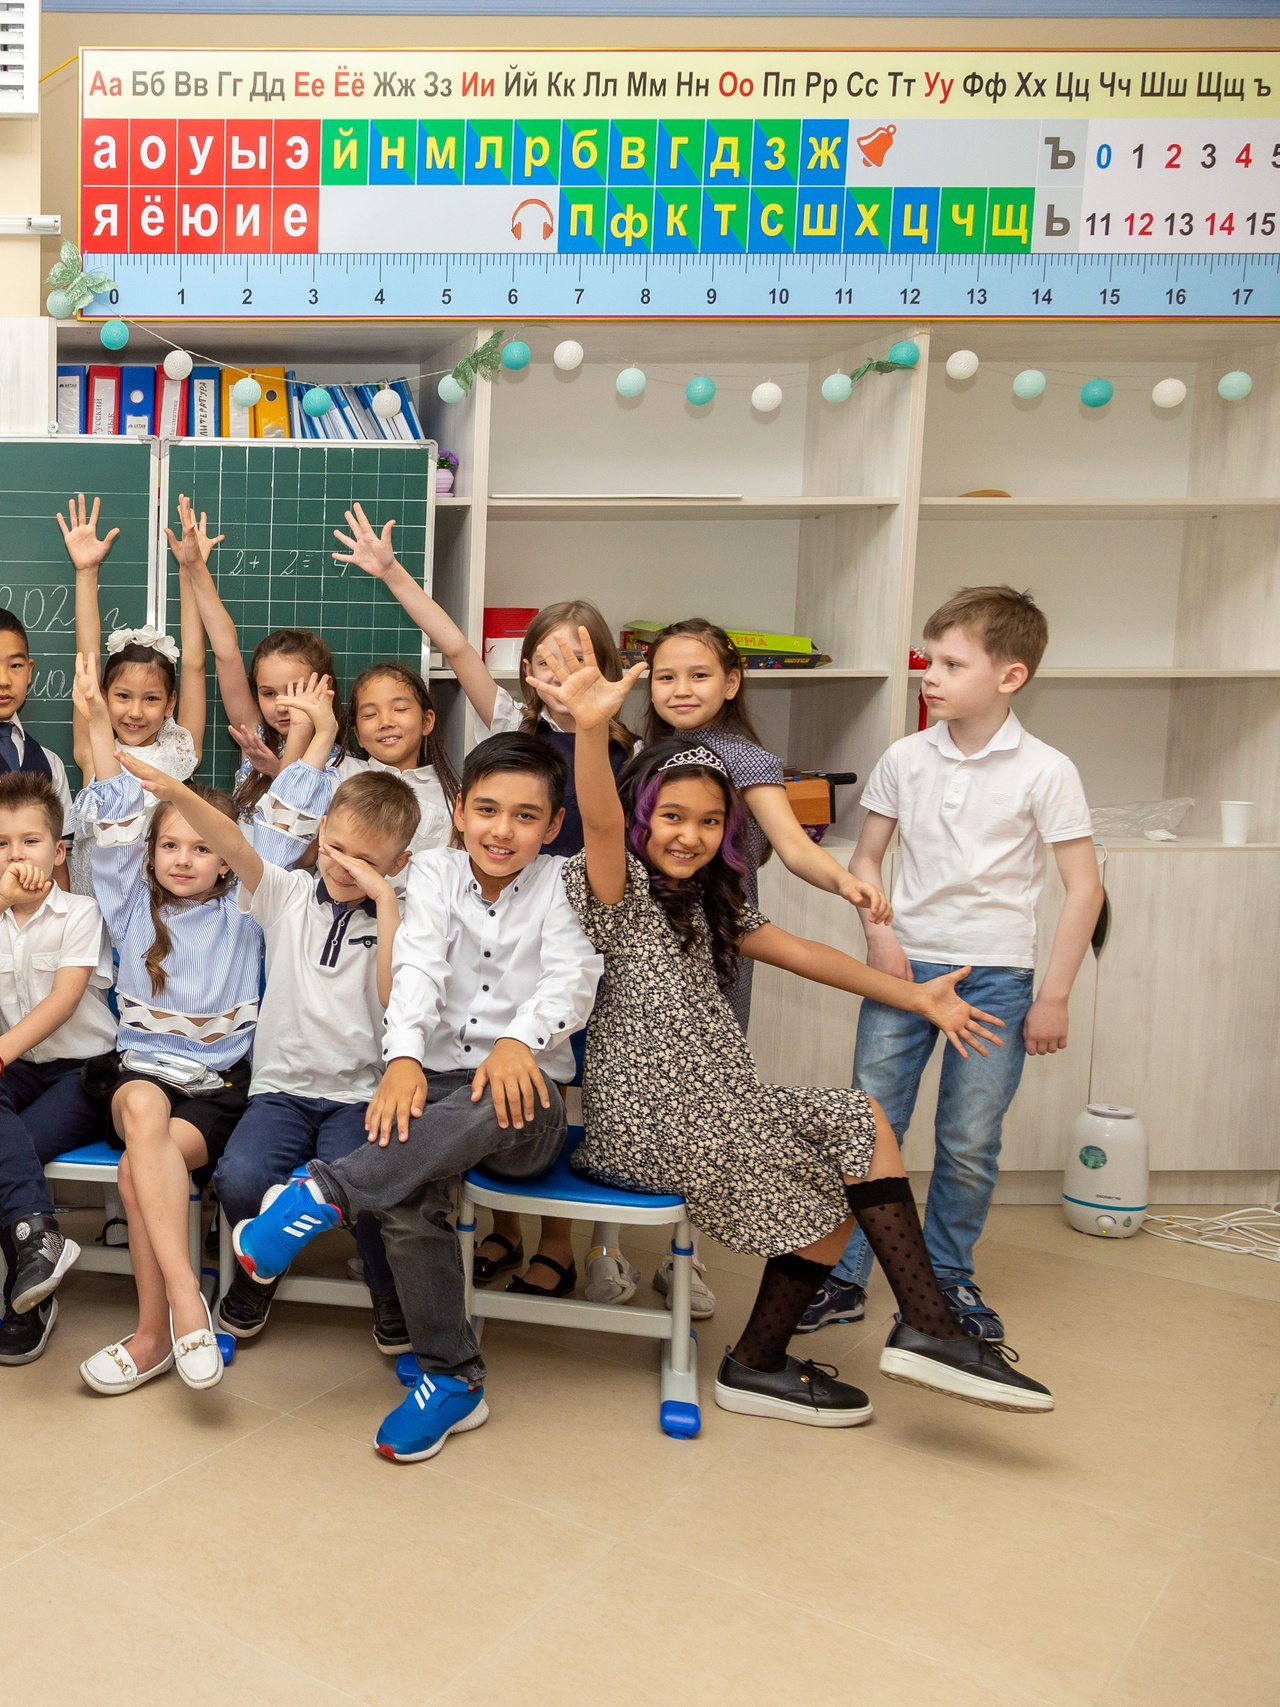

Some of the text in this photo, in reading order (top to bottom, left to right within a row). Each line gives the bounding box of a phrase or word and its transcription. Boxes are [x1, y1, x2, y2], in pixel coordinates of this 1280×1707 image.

[89, 71, 123, 97] Аа
[131, 70, 166, 97] Бб
[174, 71, 208, 97] Вв
[218, 71, 243, 97] Гг
[249, 71, 286, 102] Дд
[294, 71, 325, 97] Ее
[333, 65, 365, 97] Ёё
[373, 71, 416, 97] Жж
[423, 71, 452, 97] Зз
[461, 71, 495, 97] Ии
[504, 65, 538, 97] Йй
[547, 71, 576, 97] Кк
[582, 71, 618, 97] Лл
[626, 71, 667, 97] Мм
[676, 71, 710, 97] Нн
[718, 71, 754, 97] Оо
[763, 71, 796, 97] Пп
[805, 71, 838, 104] Рр
[846, 71, 879, 98] Сс
[887, 71, 917, 97] Тт
[924, 71, 955, 105] Уу
[962, 71, 1007, 104] Фф
[1014, 71, 1048, 98] Хх
[1055, 71, 1090, 103] Цц
[1099, 71, 1132, 98] Чч
[1140, 71, 1188, 98] Шш
[1196, 71, 1245, 103] Щщ
[93, 135, 117, 169] а
[140, 135, 166, 170] о
[188, 135, 214, 176] у
[333, 127, 358, 170] й
[524, 136, 550, 177] р
[572, 128, 598, 169] б
[1096, 143, 1112, 169] 0
[1132, 143, 1144, 169] 1
[1164, 143, 1182, 169] 2
[1200, 143, 1217, 169] 3
[1235, 143, 1253, 169] 4
[93, 203, 118, 236] я
[140, 195, 165, 236] ё
[181, 203, 218, 237] ю
[236, 203, 260, 237] и
[283, 203, 308, 237] е
[610, 203, 648, 247] ф
[1085, 212, 1276, 236] 11 12 13 14 15
[109, 288, 1254, 305] 0 1 2 3 4 5 6 7 8 9 10 11 12 13 14 15 16 17
[198, 382, 208, 437] ЛИТЕРАТУРА
[229, 550, 244, 576] 2
[249, 556, 260, 569] +
[280, 550, 299, 577] 2
